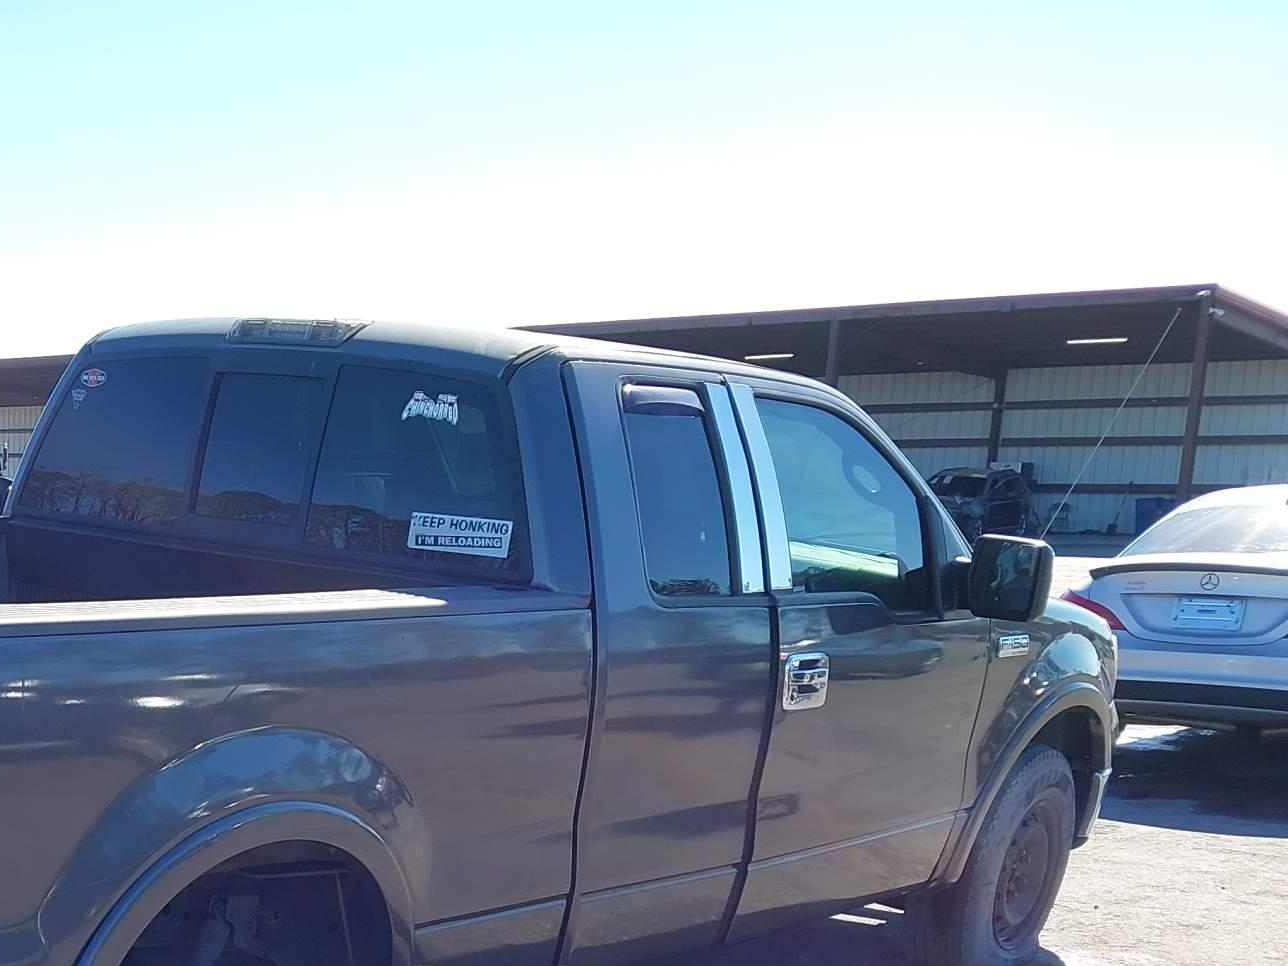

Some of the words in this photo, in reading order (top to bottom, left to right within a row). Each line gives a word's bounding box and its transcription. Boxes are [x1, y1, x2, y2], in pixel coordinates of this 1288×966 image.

[450, 518, 509, 535] HONKING
[418, 536, 434, 545] I'M
[438, 536, 501, 547] RELOADING
